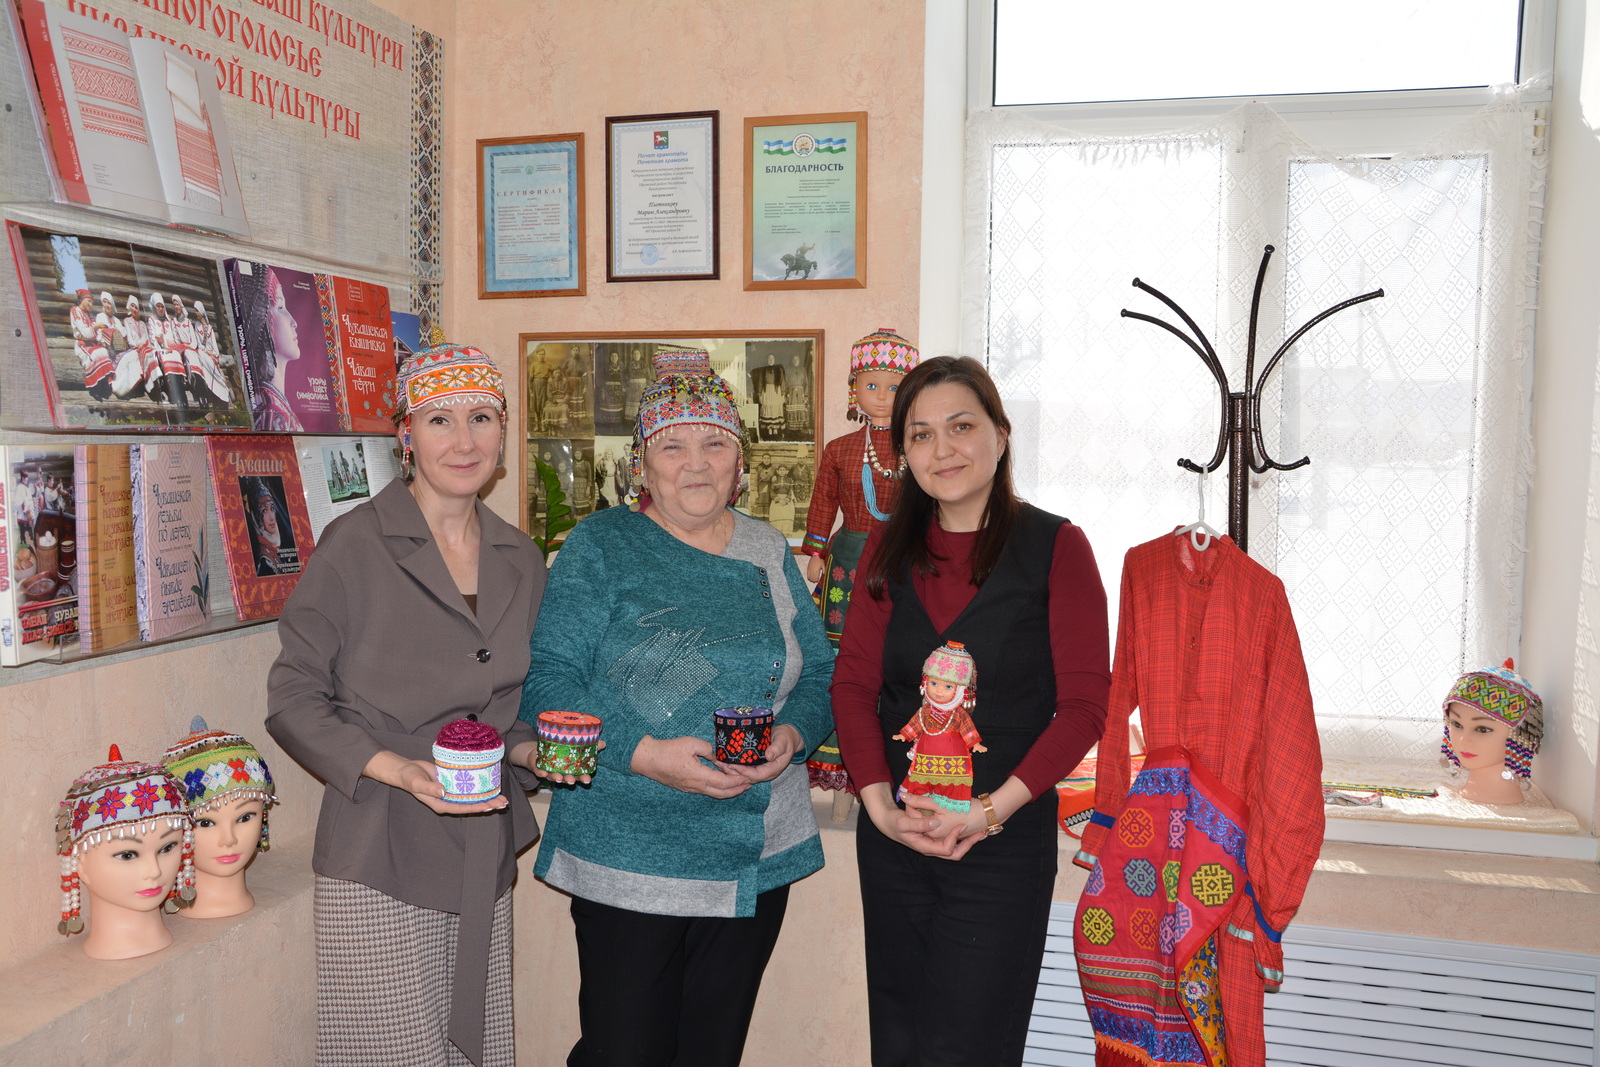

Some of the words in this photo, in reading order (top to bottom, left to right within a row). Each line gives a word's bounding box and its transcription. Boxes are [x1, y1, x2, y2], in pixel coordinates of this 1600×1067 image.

[133, 0, 323, 78] НОГОГОЛОСЬЕ
[250, 70, 361, 141] КУЛЬТУРЫ
[765, 163, 844, 174] БЛАГОДАРНОСТЬ
[496, 188, 562, 197] СЕРТИФИКАТ
[228, 452, 285, 474] Чуваши
